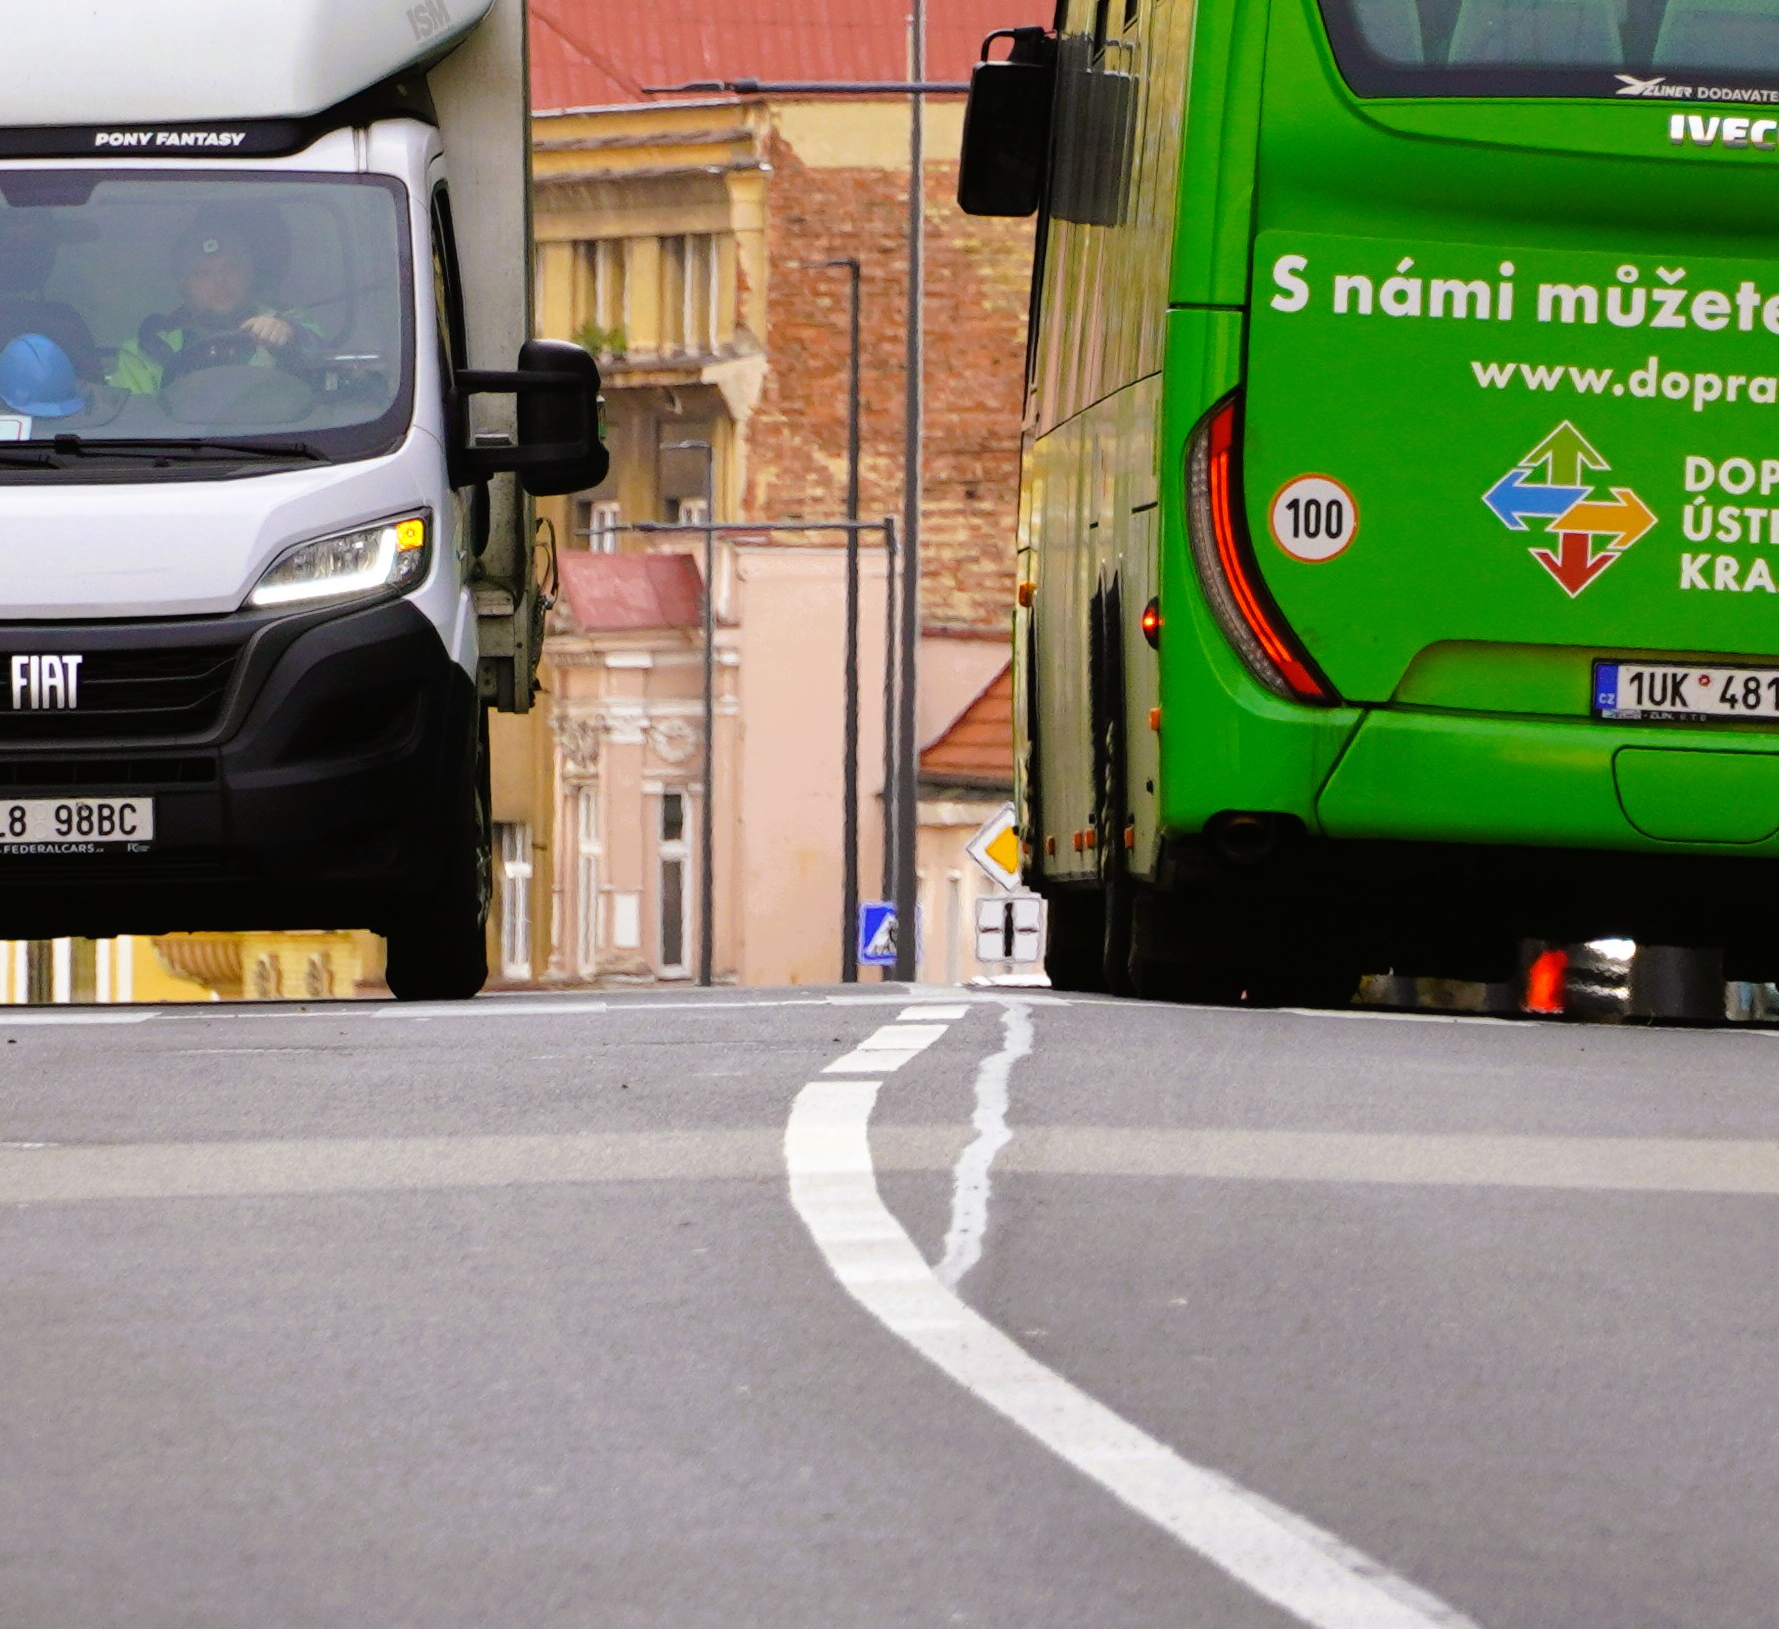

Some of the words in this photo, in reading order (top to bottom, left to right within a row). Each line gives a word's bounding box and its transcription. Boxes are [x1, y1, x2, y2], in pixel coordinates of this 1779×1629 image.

[95, 132, 153, 146] PONY
[156, 132, 246, 146] FANTASY
[1270, 254, 1310, 312] S
[1333, 256, 1515, 320] námi
[1285, 498, 1343, 539] 100
[11, 655, 83, 709] FIAT
[1598, 693, 1615, 705] CZ
[1629, 672, 1689, 708] 1UK
[55, 803, 137, 837] 98BC
